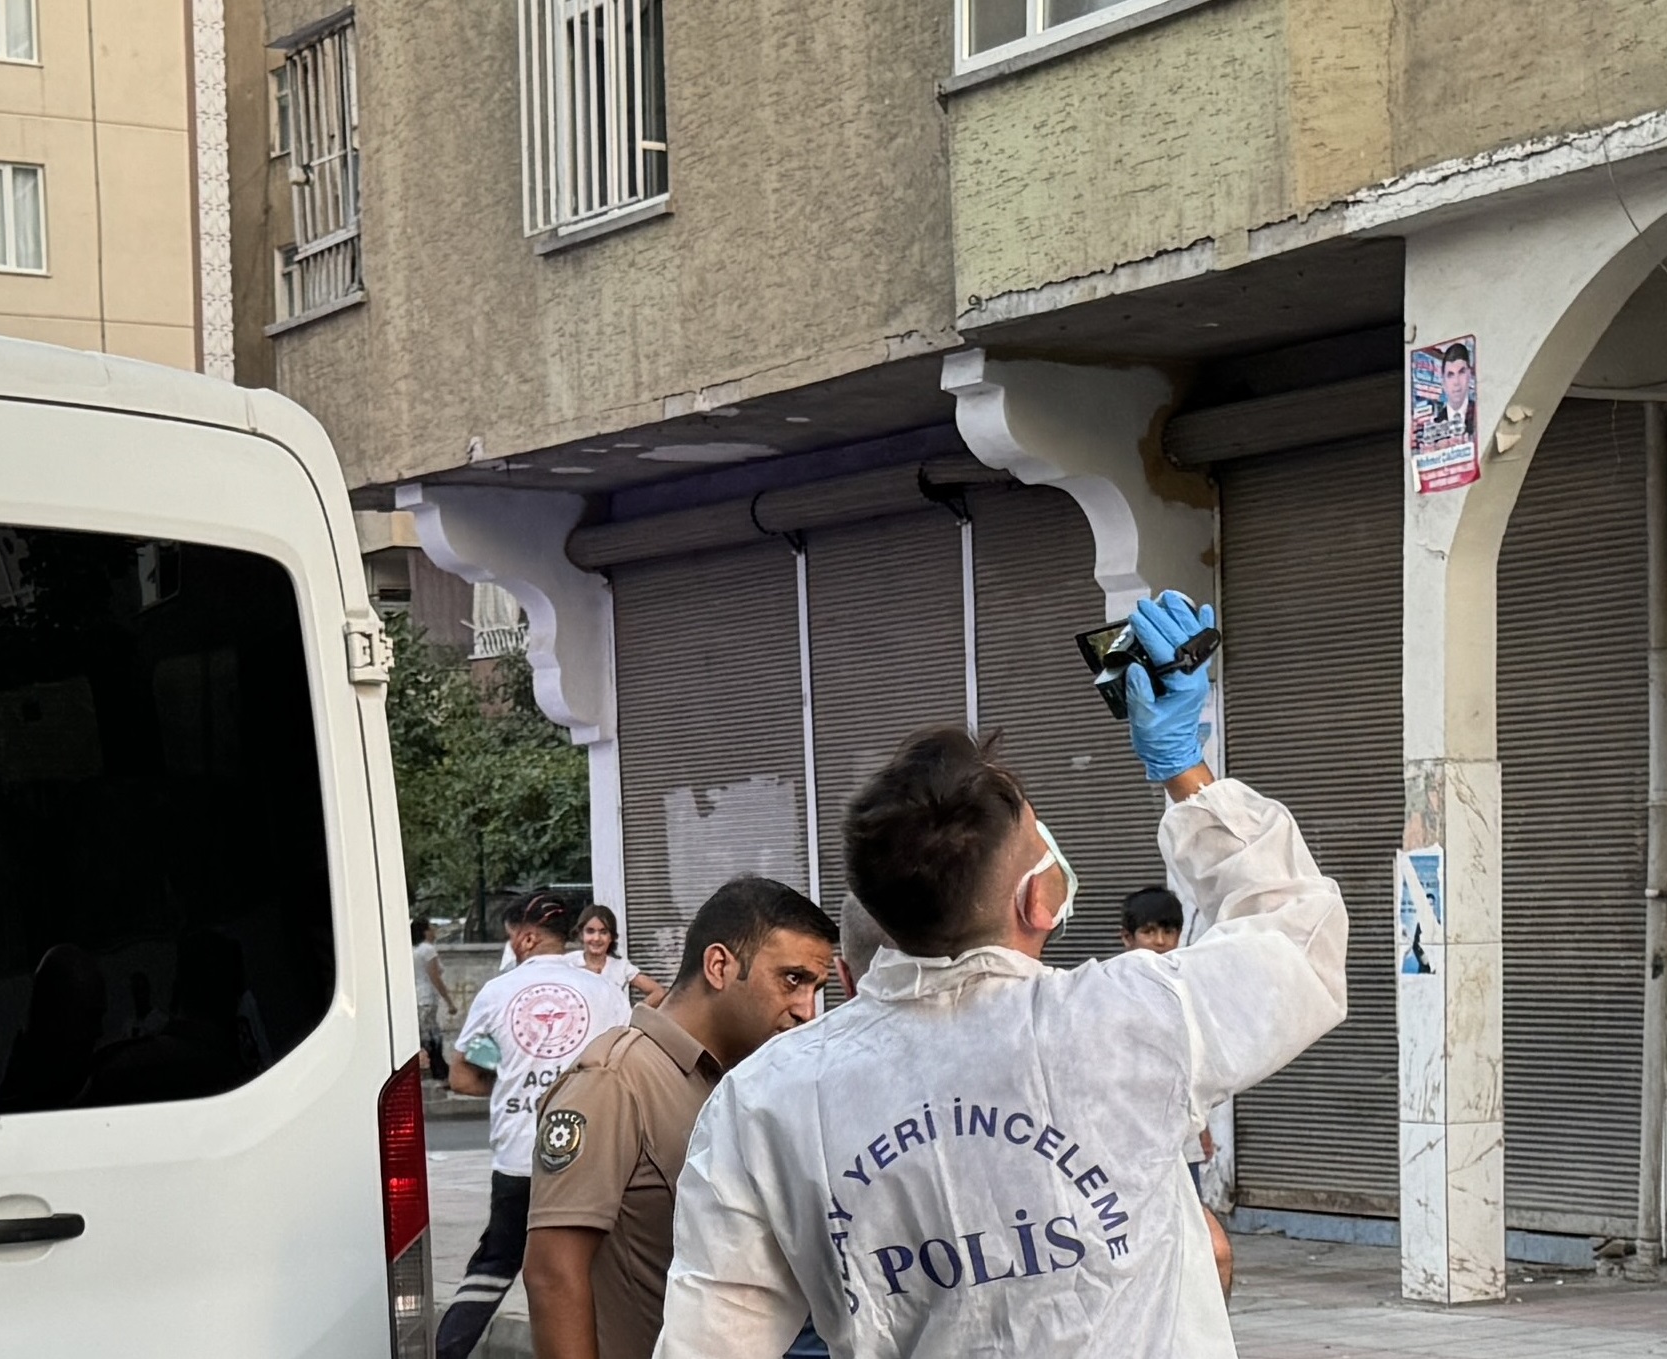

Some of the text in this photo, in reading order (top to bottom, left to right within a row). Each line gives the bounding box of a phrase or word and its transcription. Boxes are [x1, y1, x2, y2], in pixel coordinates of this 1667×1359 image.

[505, 1096, 540, 1114] SA
[843, 1103, 937, 1187] YERİ
[953, 1097, 1130, 1261] İNCELEME
[870, 1208, 1087, 1297] POLİS
